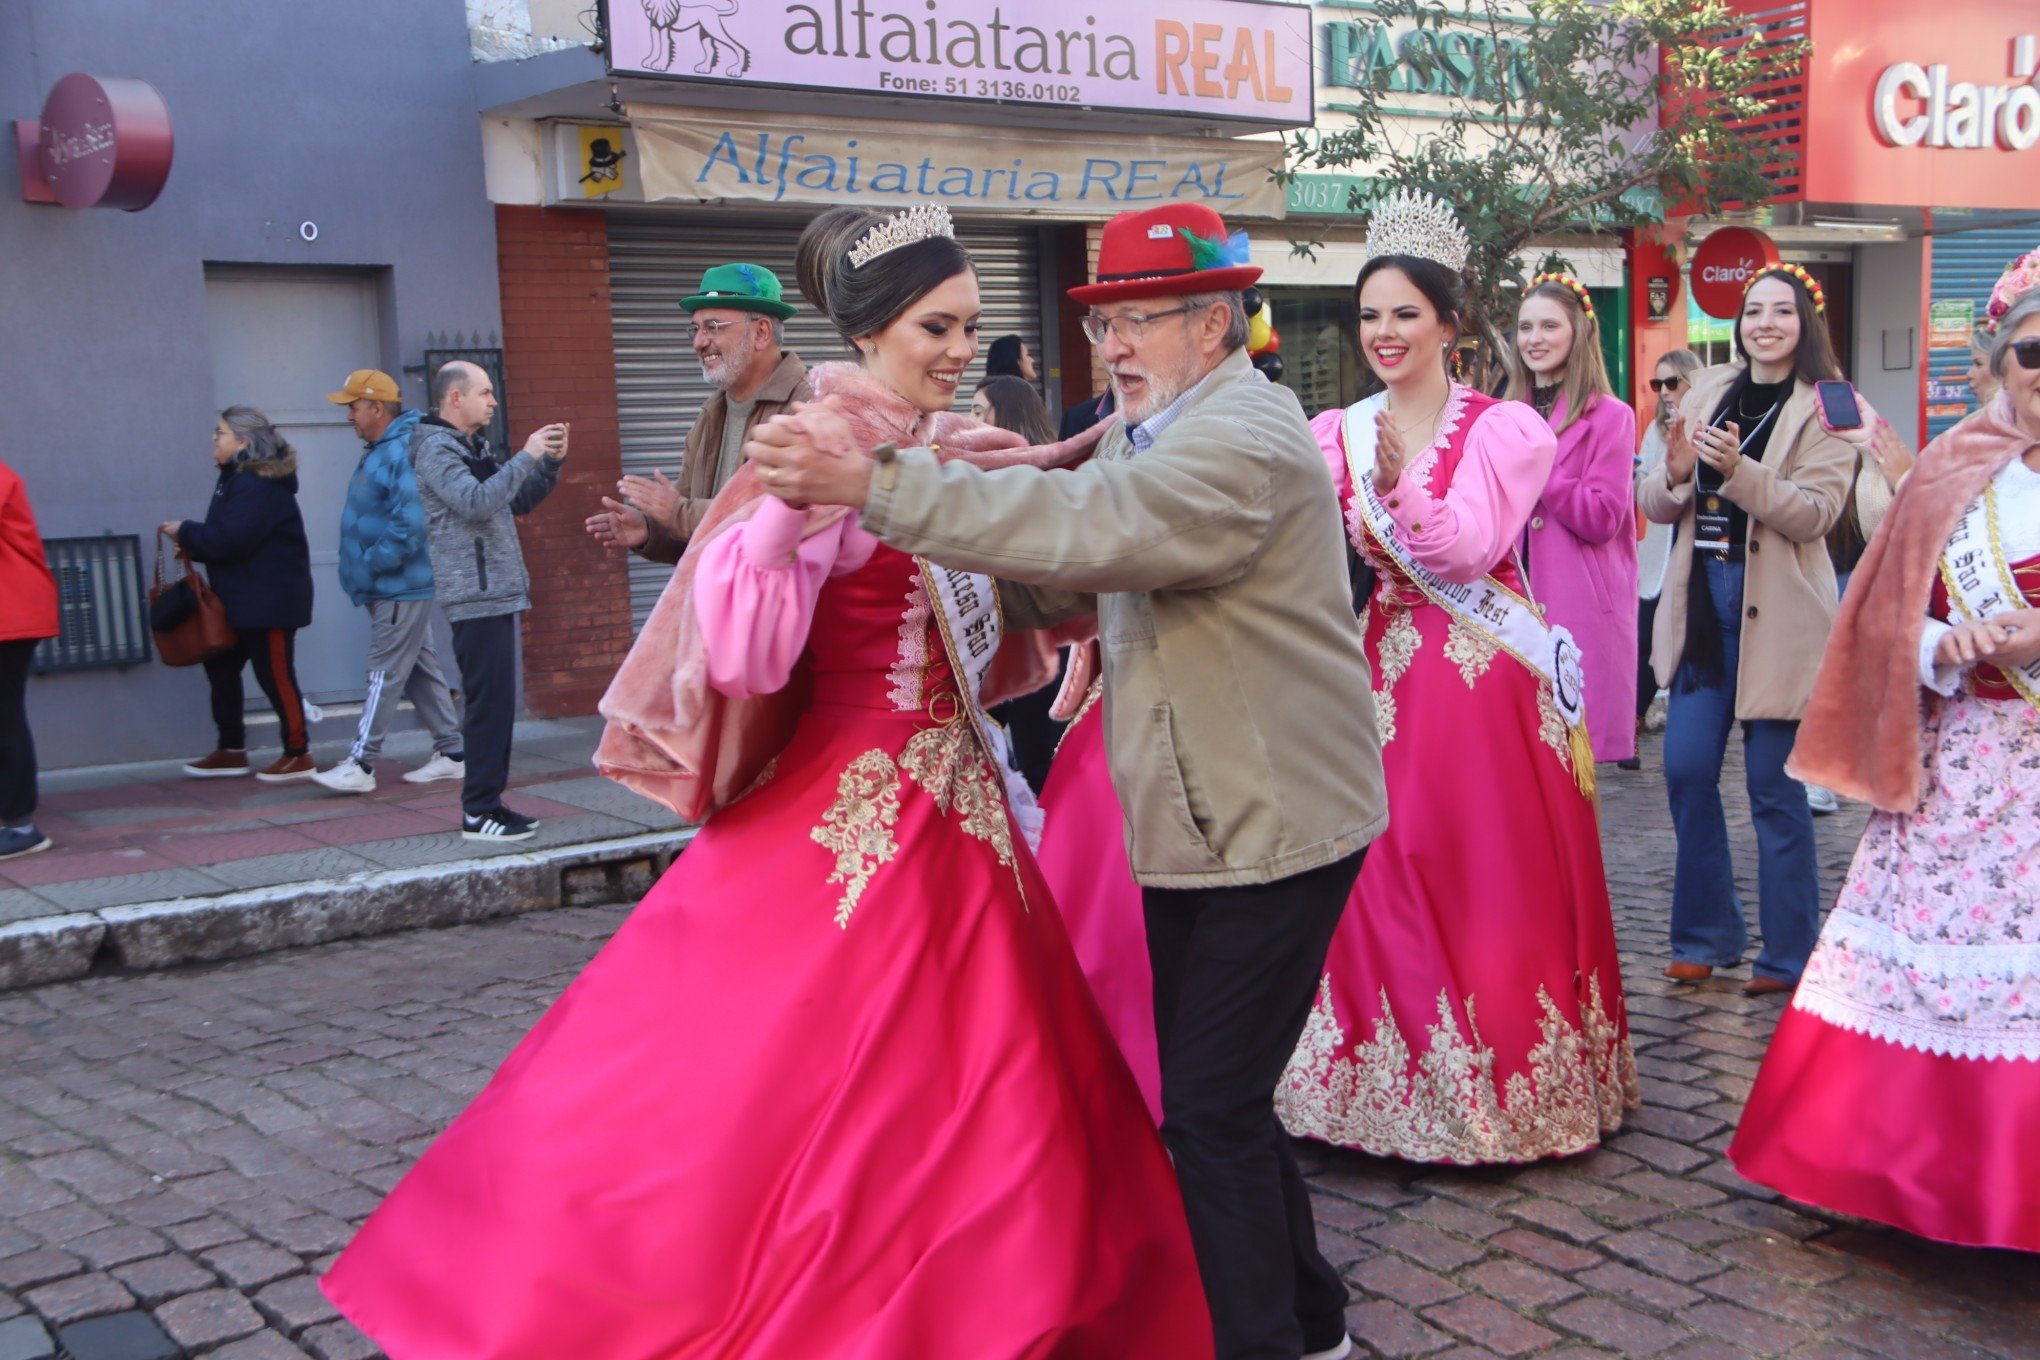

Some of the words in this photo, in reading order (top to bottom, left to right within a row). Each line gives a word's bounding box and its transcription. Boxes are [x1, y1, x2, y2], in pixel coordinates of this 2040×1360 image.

[784, 0, 1140, 80] alfaiataria
[1154, 18, 1293, 103] REAL
[879, 71, 938, 93] Fone:
[944, 77, 968, 95] 51
[976, 79, 1081, 103] 3136.0102
[1873, 61, 2040, 150] Claro
[695, 131, 1062, 201] Alfaiataria
[1075, 158, 1245, 201] REAL
[1290, 180, 1342, 208] 3037
[1702, 265, 1747, 283] Claro
[1954, 547, 1984, 592] São
[1473, 588, 1509, 626] Fest
[963, 612, 996, 659] São
